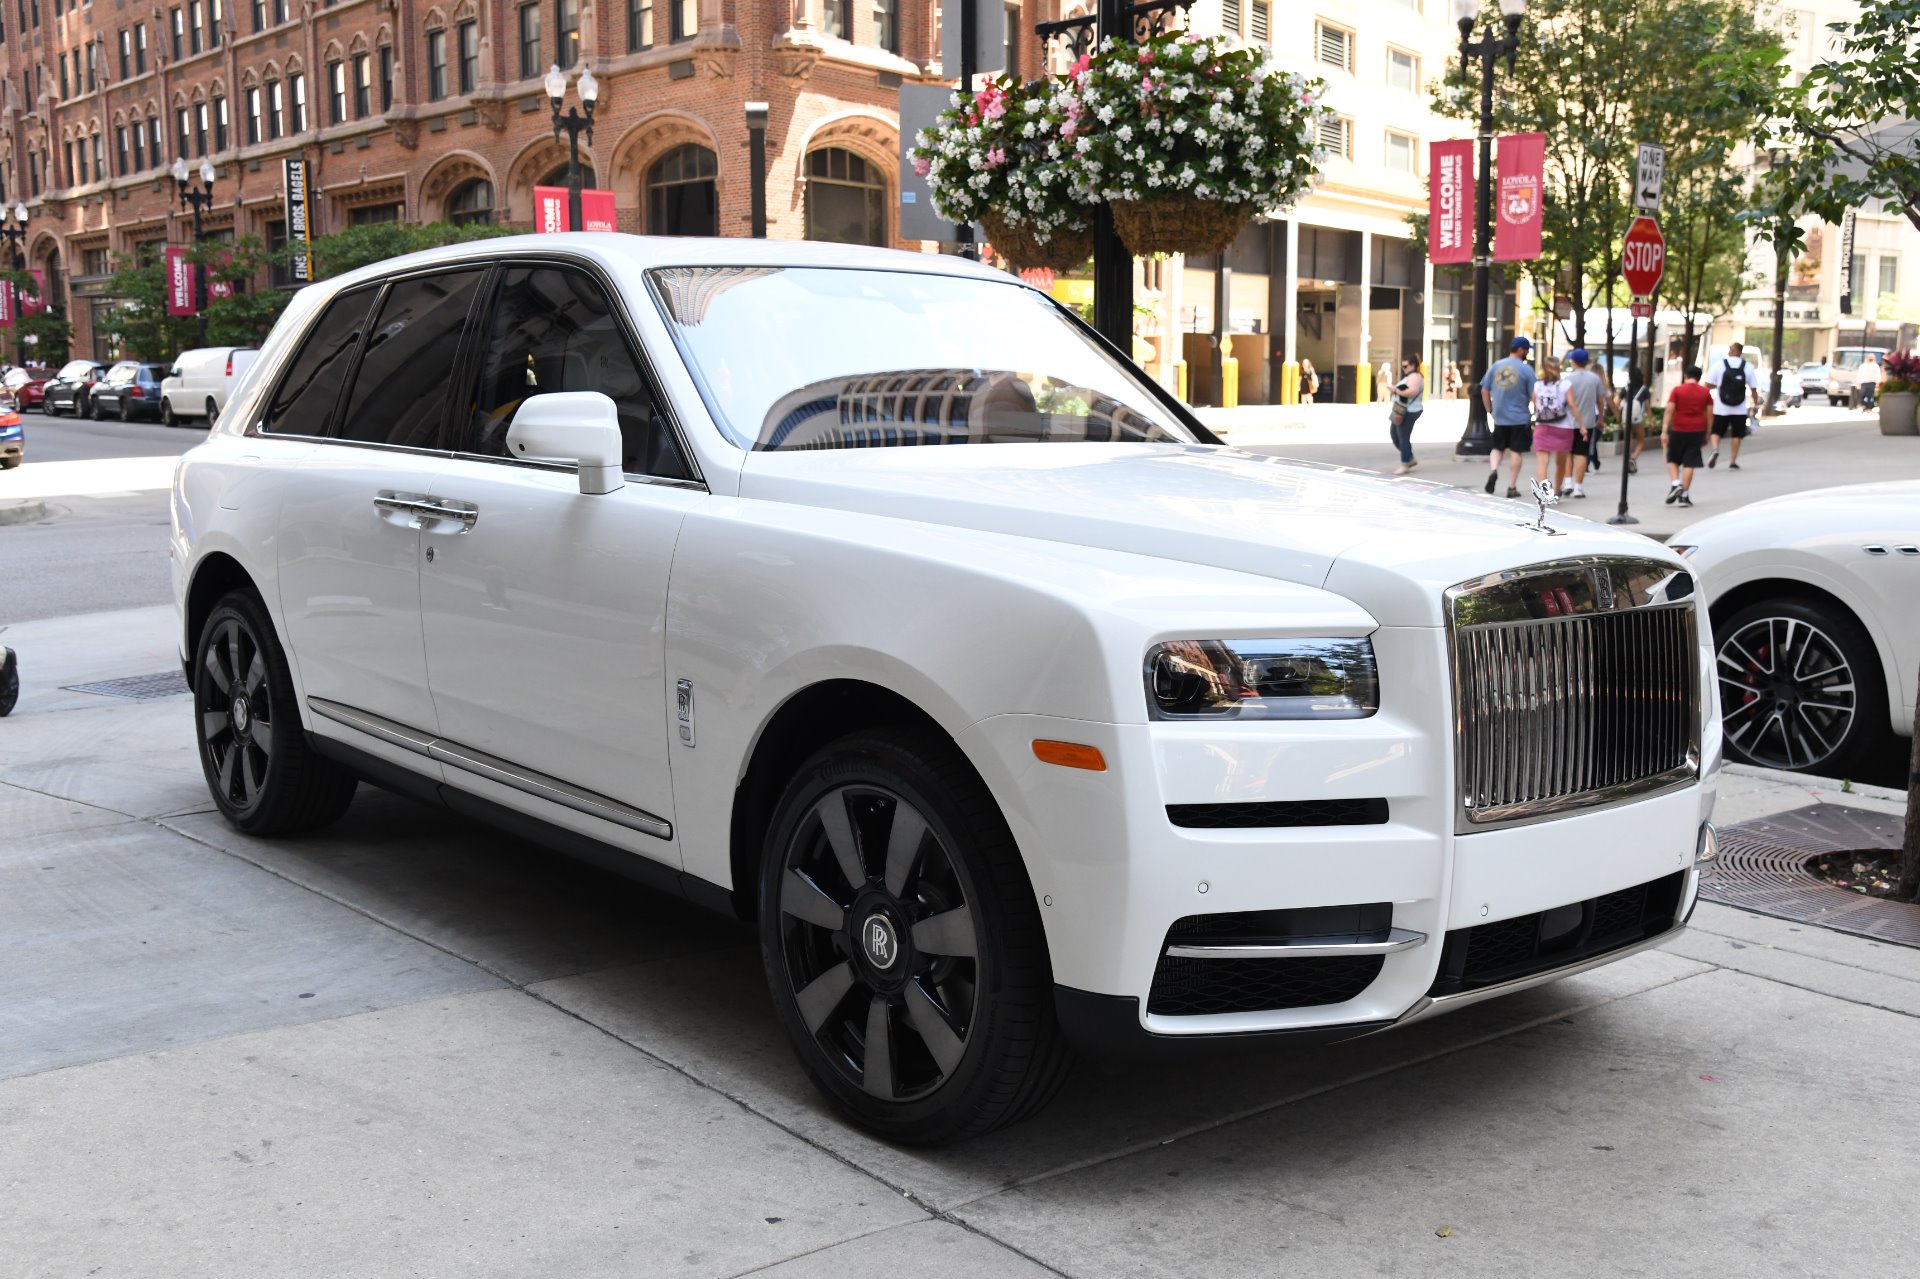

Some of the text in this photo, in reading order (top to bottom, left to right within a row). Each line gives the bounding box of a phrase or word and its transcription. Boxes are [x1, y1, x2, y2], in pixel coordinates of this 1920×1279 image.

[1642, 150, 1661, 167] ONE
[290, 161, 304, 201] BAGELS
[1502, 176, 1537, 185] LOYOLA
[1640, 168, 1660, 184] WAY
[1440, 154, 1454, 249] WELCOME
[1454, 154, 1462, 249] WATER TOWER CAMPUS
[587, 220, 612, 229] LOYOLA
[1625, 241, 1662, 272] STOP
[173, 256, 184, 307] WELCOME
[872, 923, 888, 959] RR
